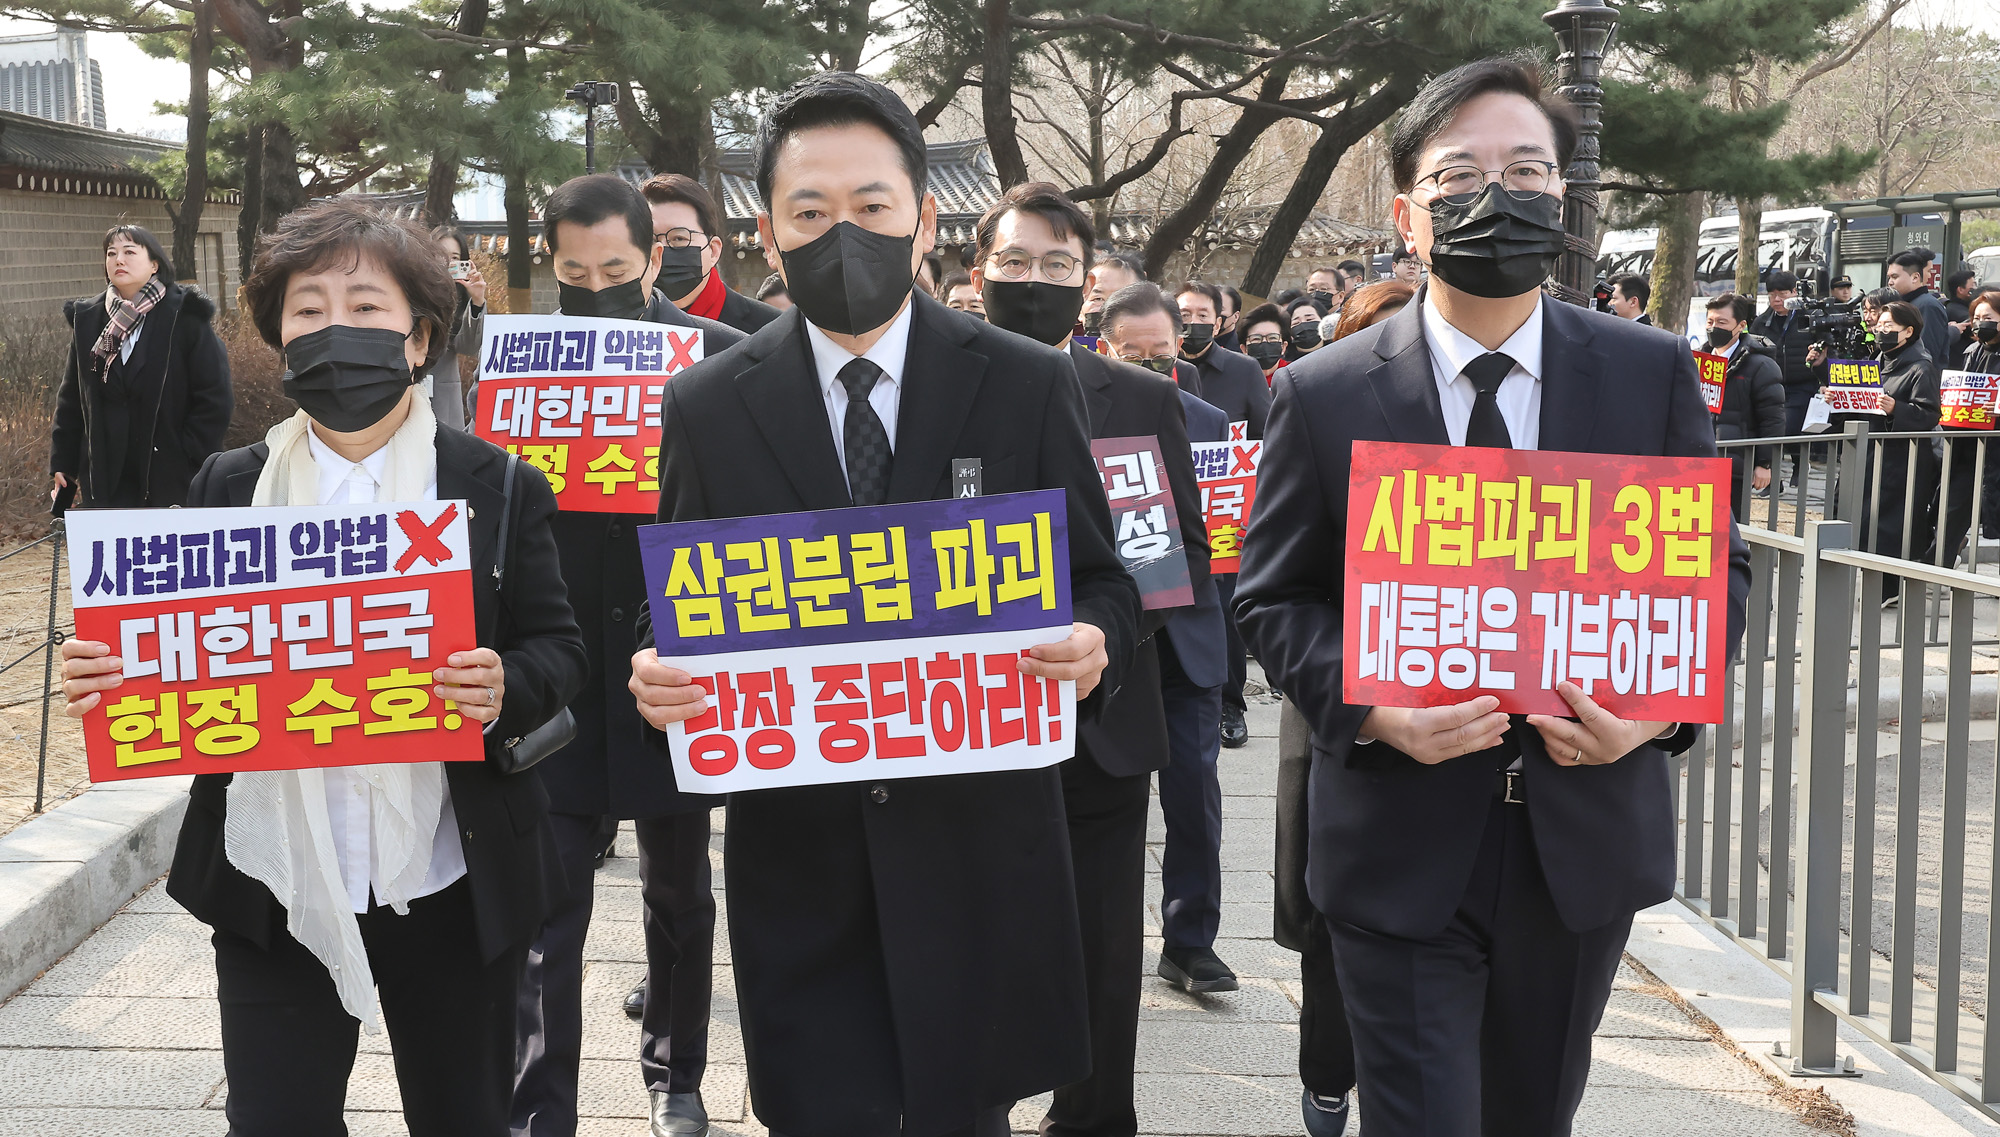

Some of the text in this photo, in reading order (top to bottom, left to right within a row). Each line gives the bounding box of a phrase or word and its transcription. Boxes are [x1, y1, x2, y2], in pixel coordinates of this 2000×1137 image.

[1907, 231, 1930, 244] 청와대
[485, 330, 663, 374] 사법파괴 악법
[1830, 363, 1881, 385] 삼권분립 파괴
[1700, 381, 1722, 408] 하라!
[1848, 390, 1882, 410] 중단하라
[1964, 375, 1986, 388] 악법
[506, 444, 570, 495] 정
[1093, 450, 1164, 502] 괴
[1362, 469, 1715, 578] 사법파괴 3법
[83, 514, 389, 598] 사법파괴 악법
[664, 512, 1057, 638] 삼권분립 파괴
[119, 589, 435, 683] 대한민국
[1358, 580, 1709, 698] 대통령은 거부하라!
[106, 684, 261, 769] 헌정
[684, 650, 1063, 777] 당장 중단하라!
